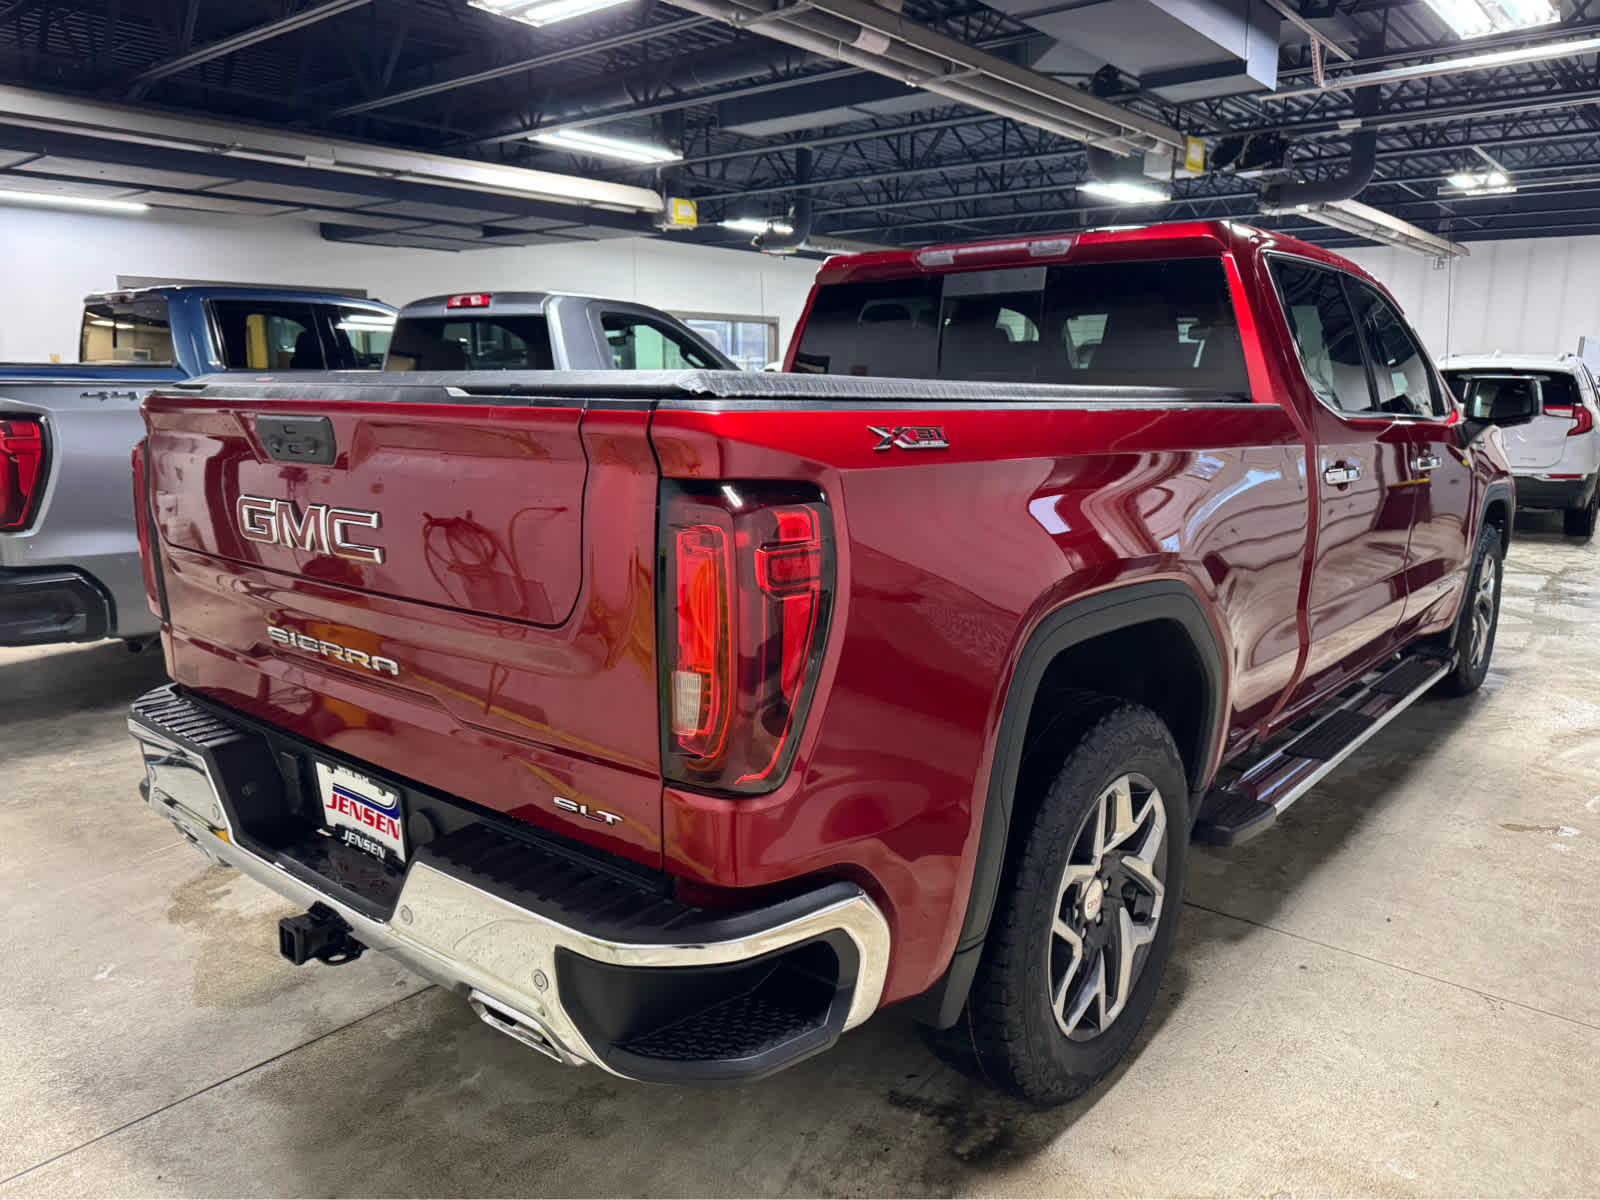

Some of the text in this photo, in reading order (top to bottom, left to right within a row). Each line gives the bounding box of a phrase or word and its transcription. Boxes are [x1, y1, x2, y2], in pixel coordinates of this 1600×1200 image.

[236, 495, 384, 564] GMC
[267, 625, 400, 675] SIERRA
[326, 793, 400, 840] JENSEN
[553, 796, 624, 825] SLT
[342, 830, 386, 859] JENSEN
